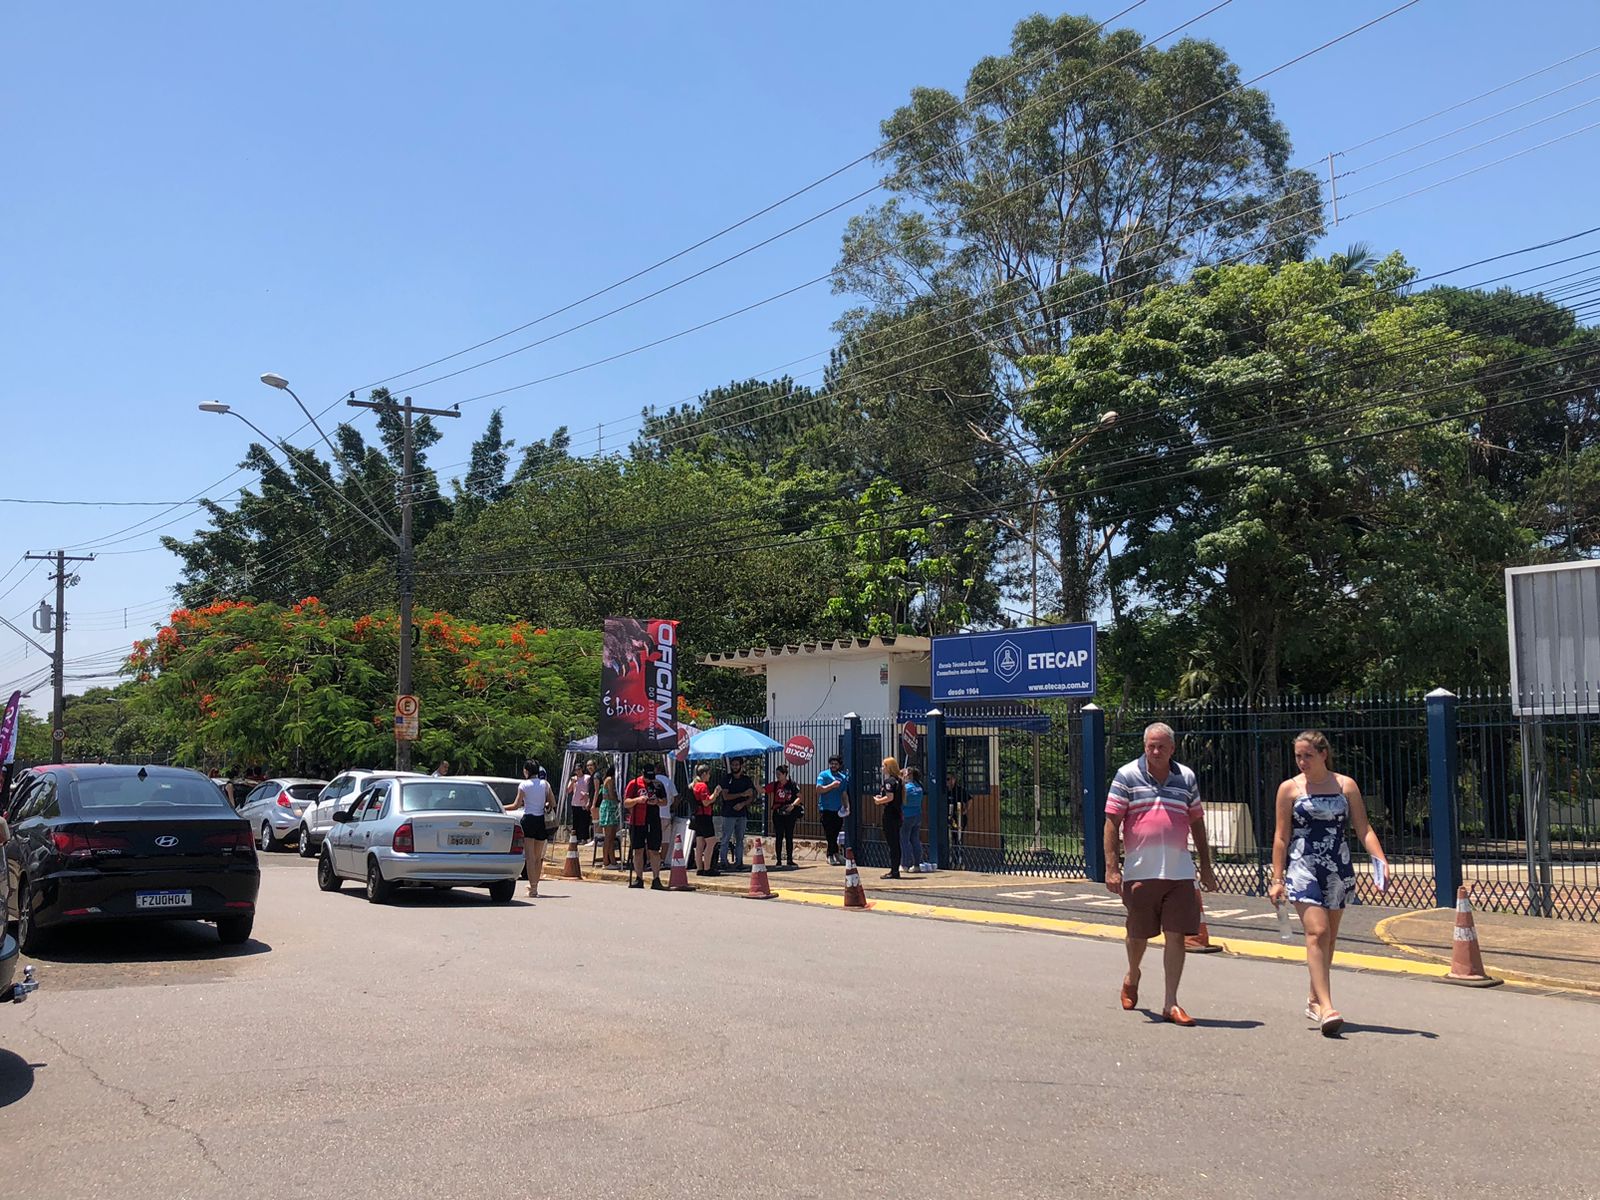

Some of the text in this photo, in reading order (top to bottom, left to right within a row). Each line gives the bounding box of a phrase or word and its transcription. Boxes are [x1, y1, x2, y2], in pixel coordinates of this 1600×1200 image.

[1028, 650, 1088, 670] ETECAP
[654, 623, 677, 740] OFICINA
[1028, 681, 1089, 692] www.etecap.com.br
[947, 688, 965, 696] desde
[616, 696, 645, 717] bixo
[648, 687, 656, 740] DO ESTUDANTE
